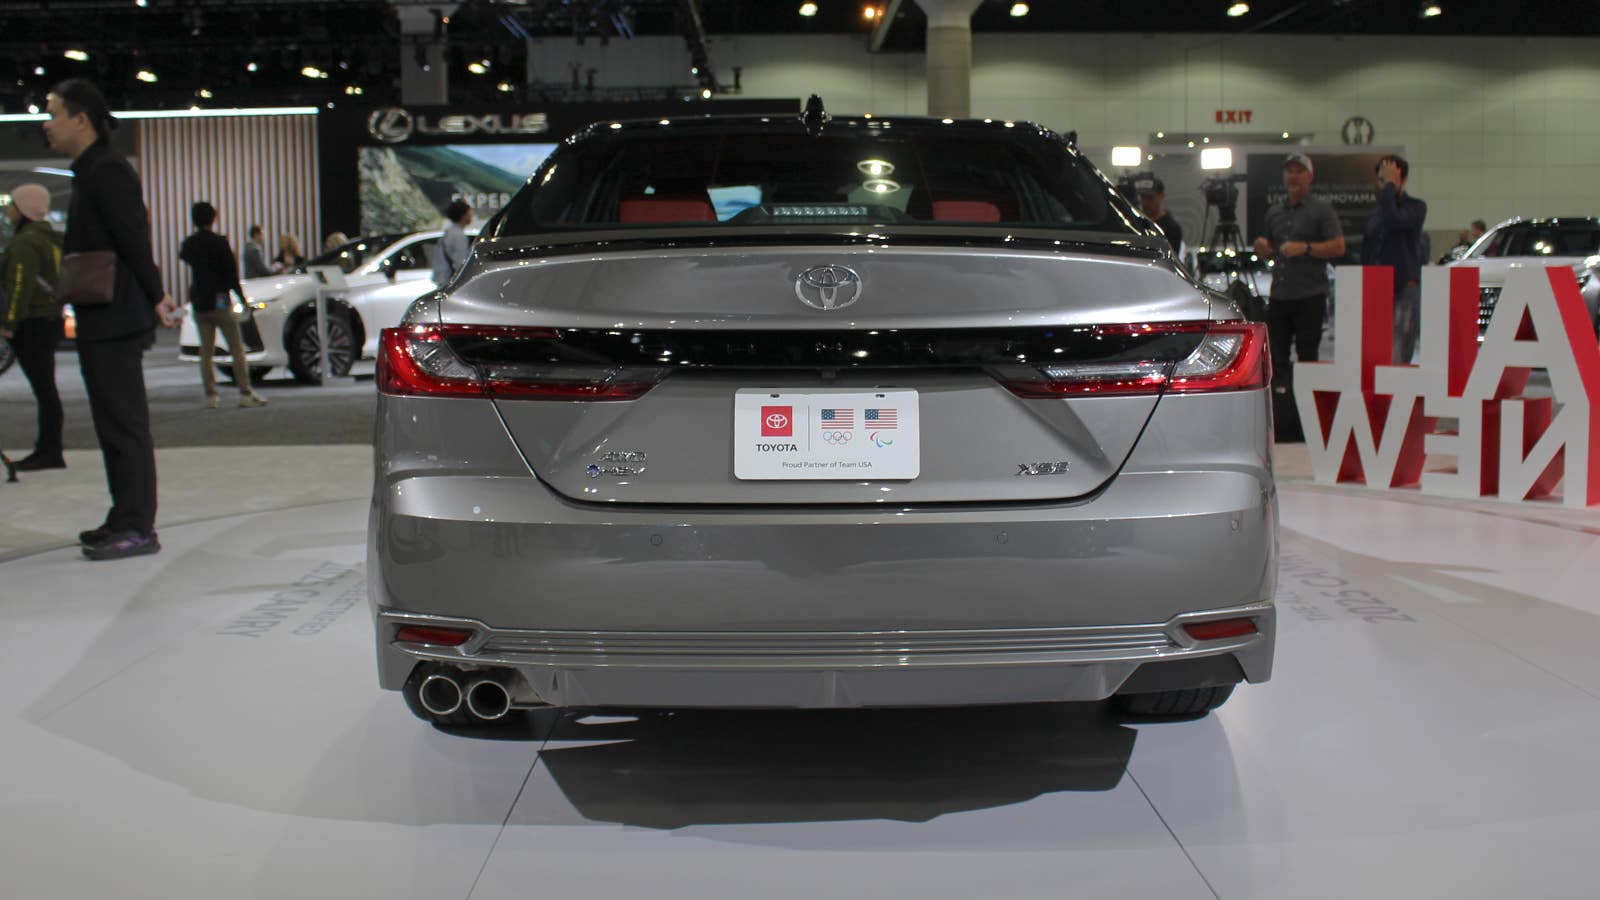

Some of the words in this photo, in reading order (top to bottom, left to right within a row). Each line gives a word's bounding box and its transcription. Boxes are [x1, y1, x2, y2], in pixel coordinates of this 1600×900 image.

[1215, 110, 1252, 124] EXIT
[417, 113, 548, 134] LEXUS
[756, 443, 798, 452] TOYOTA
[782, 461, 802, 469] Proud
[804, 461, 829, 469] Partner
[829, 461, 837, 469] of
[839, 461, 857, 469] Team
[858, 461, 872, 469] USA
